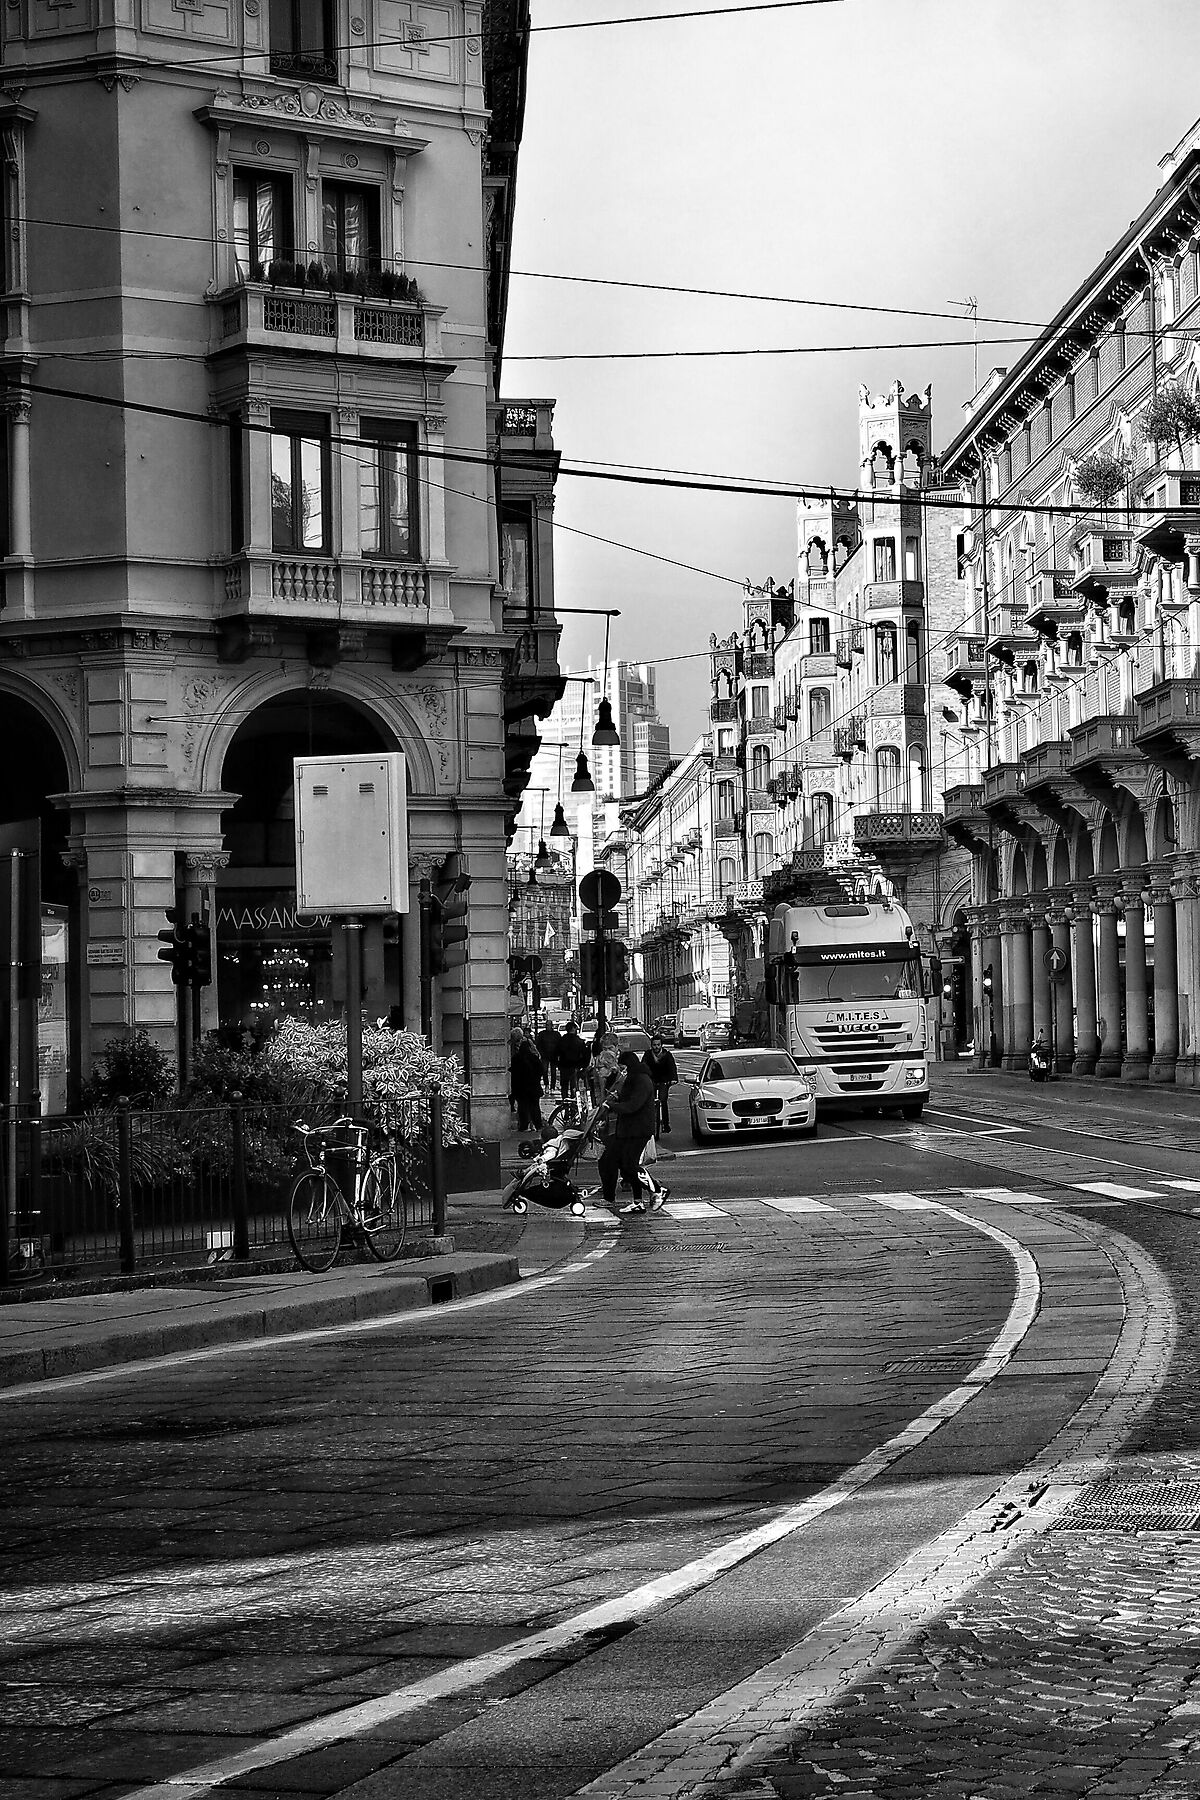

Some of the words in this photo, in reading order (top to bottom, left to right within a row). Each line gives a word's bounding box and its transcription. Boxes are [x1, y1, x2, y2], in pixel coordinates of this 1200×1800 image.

[820, 949, 887, 960] www.mites.it
[836, 1011, 880, 1022] M.I.T.E.S
[838, 1023, 880, 1034] IVECO
